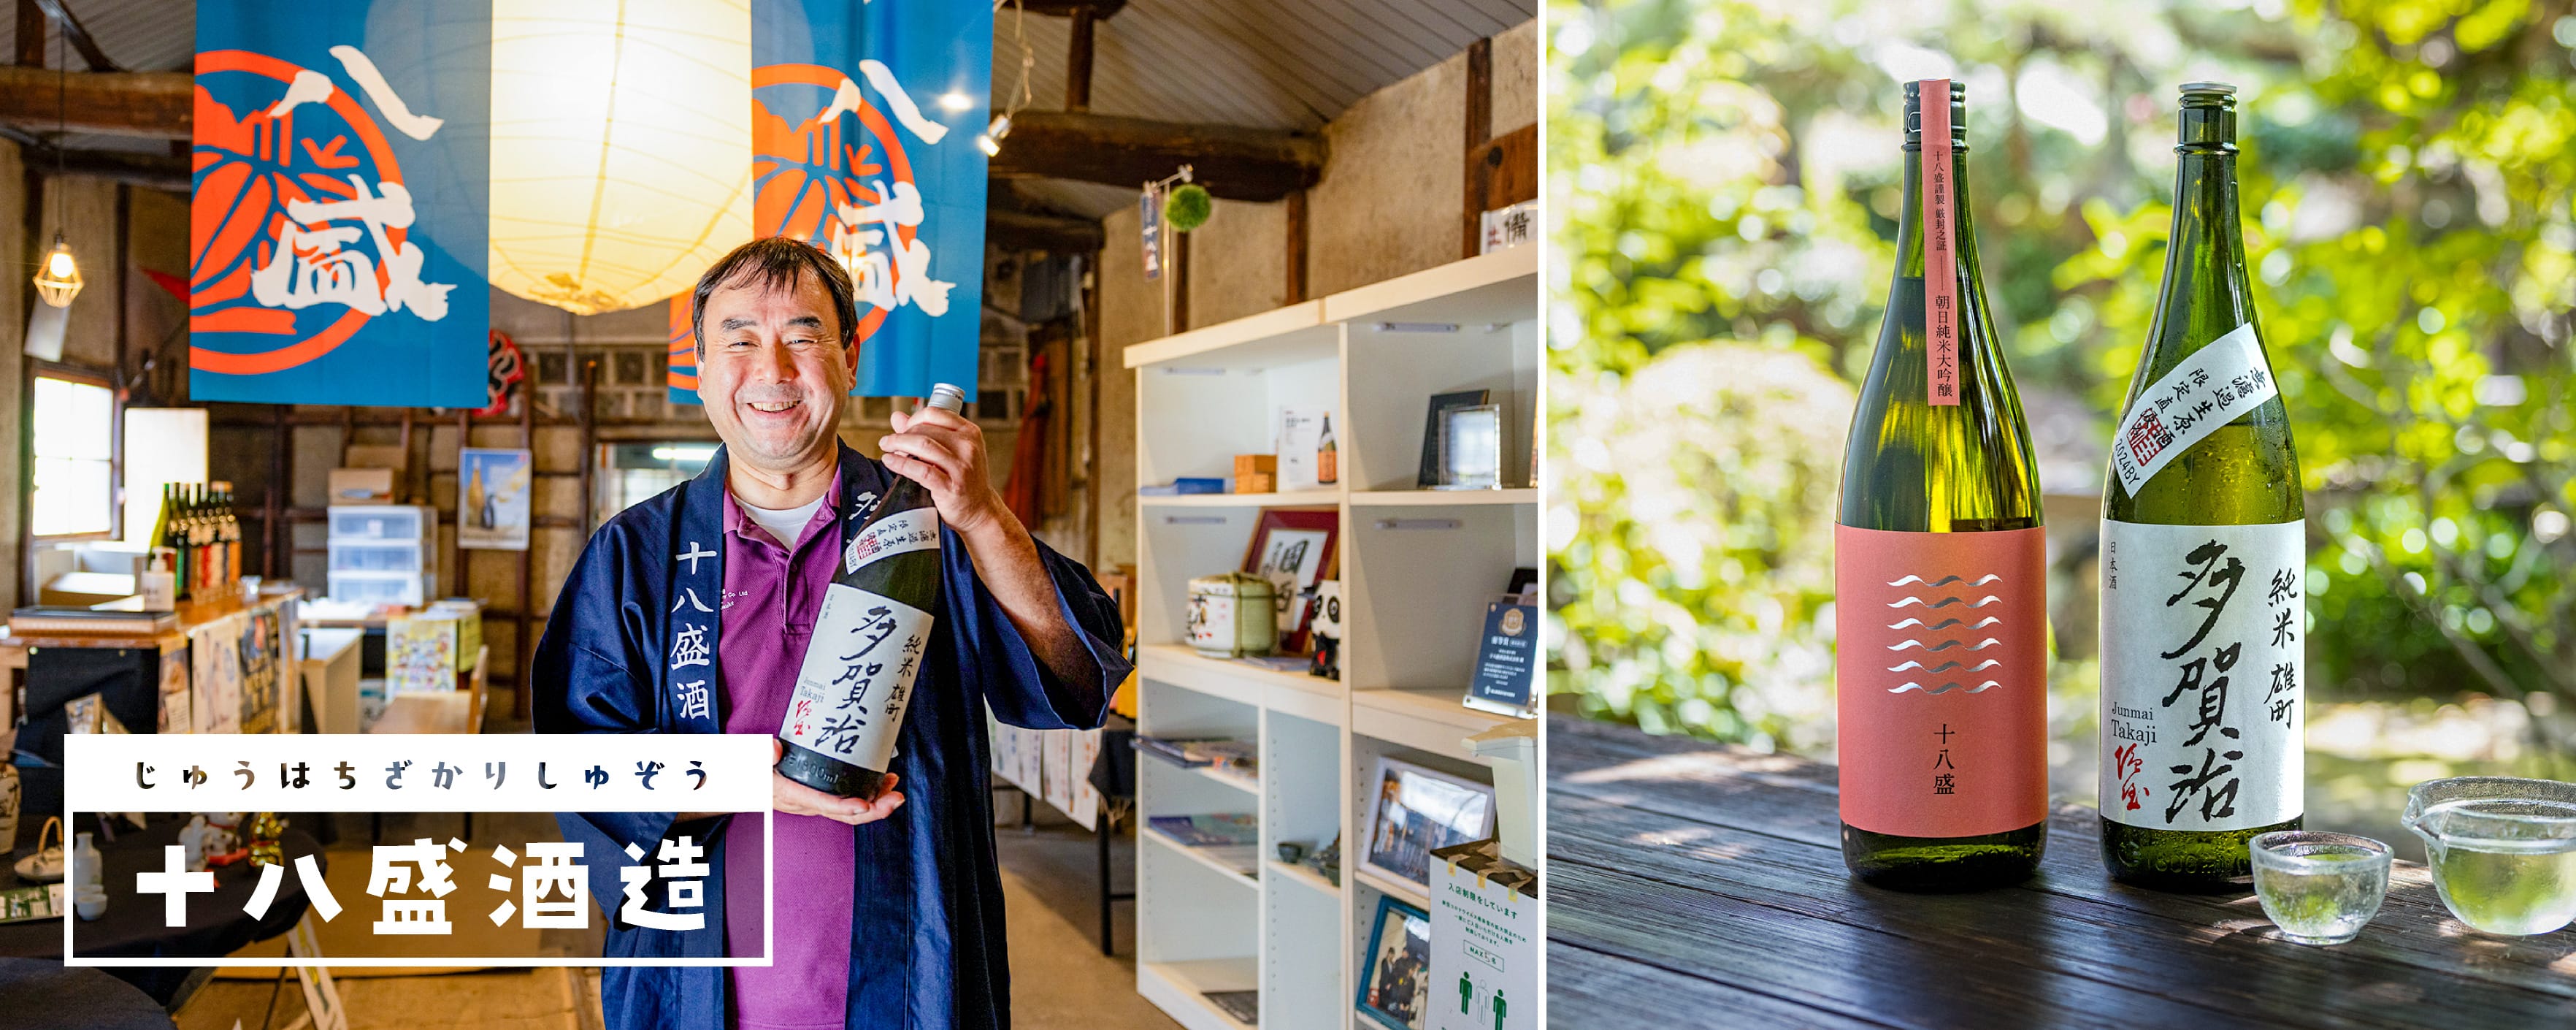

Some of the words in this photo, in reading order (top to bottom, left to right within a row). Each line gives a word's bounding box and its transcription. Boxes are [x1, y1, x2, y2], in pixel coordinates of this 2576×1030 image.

[2115, 438, 2140, 485] 2024BY
[2109, 541, 2118, 590] 日本酒
[2268, 567, 2298, 649] 純米
[814, 604, 897, 755] 多賀治
[898, 633, 922, 679] 純米
[800, 686, 826, 703] Takaji
[884, 682, 906, 722] 雄町
[2161, 539, 2246, 824] 多賀治
[2263, 661, 2296, 730] 雄町
[2111, 718, 2158, 747] Takaji
[2112, 701, 2154, 721] Junmai
[1933, 723, 1955, 796] 十八盛
